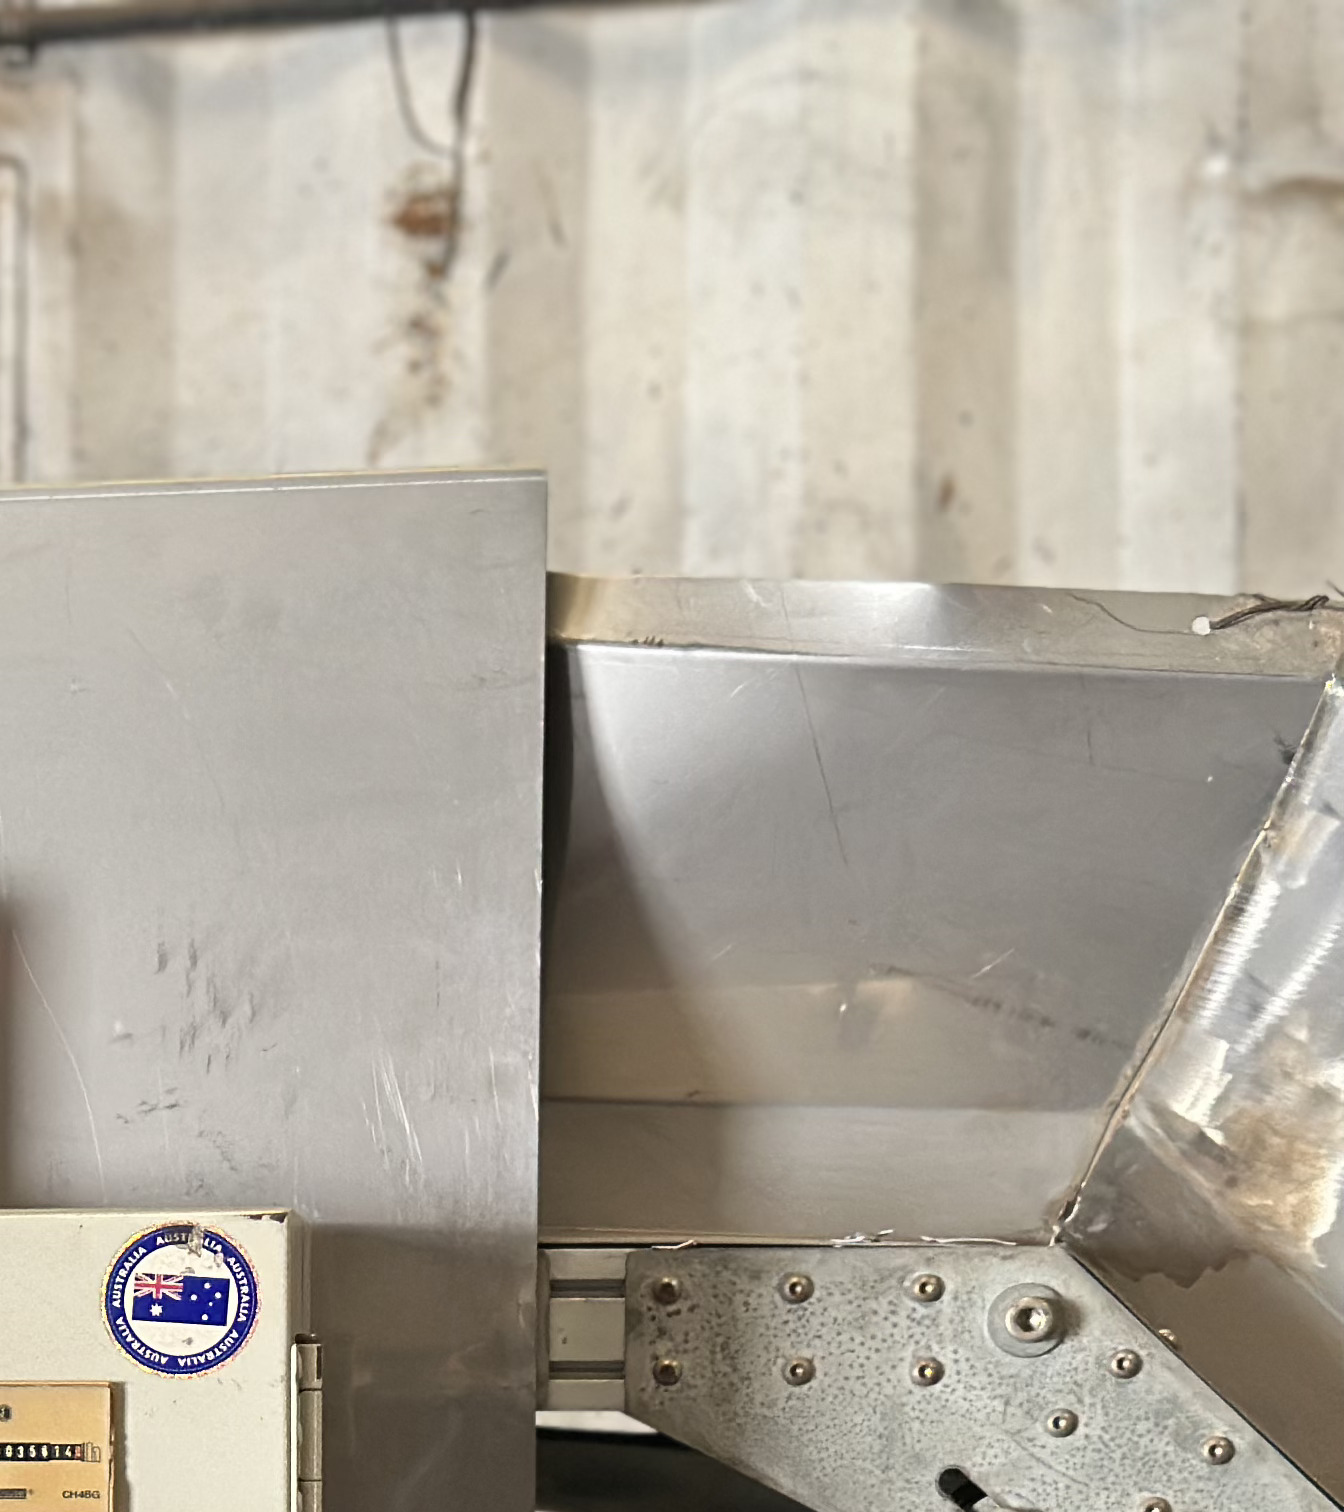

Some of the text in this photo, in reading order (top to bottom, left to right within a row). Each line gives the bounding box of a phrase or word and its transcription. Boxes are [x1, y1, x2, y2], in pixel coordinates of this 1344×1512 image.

[156, 1231, 224, 1253] AUSTLIA
[111, 1246, 148, 1309] AUSTRALIA
[226, 1256, 251, 1323] AUSTRALIA
[115, 1315, 170, 1366] AUSTRALIA
[177, 1328, 240, 1368] AUSTRALIA
